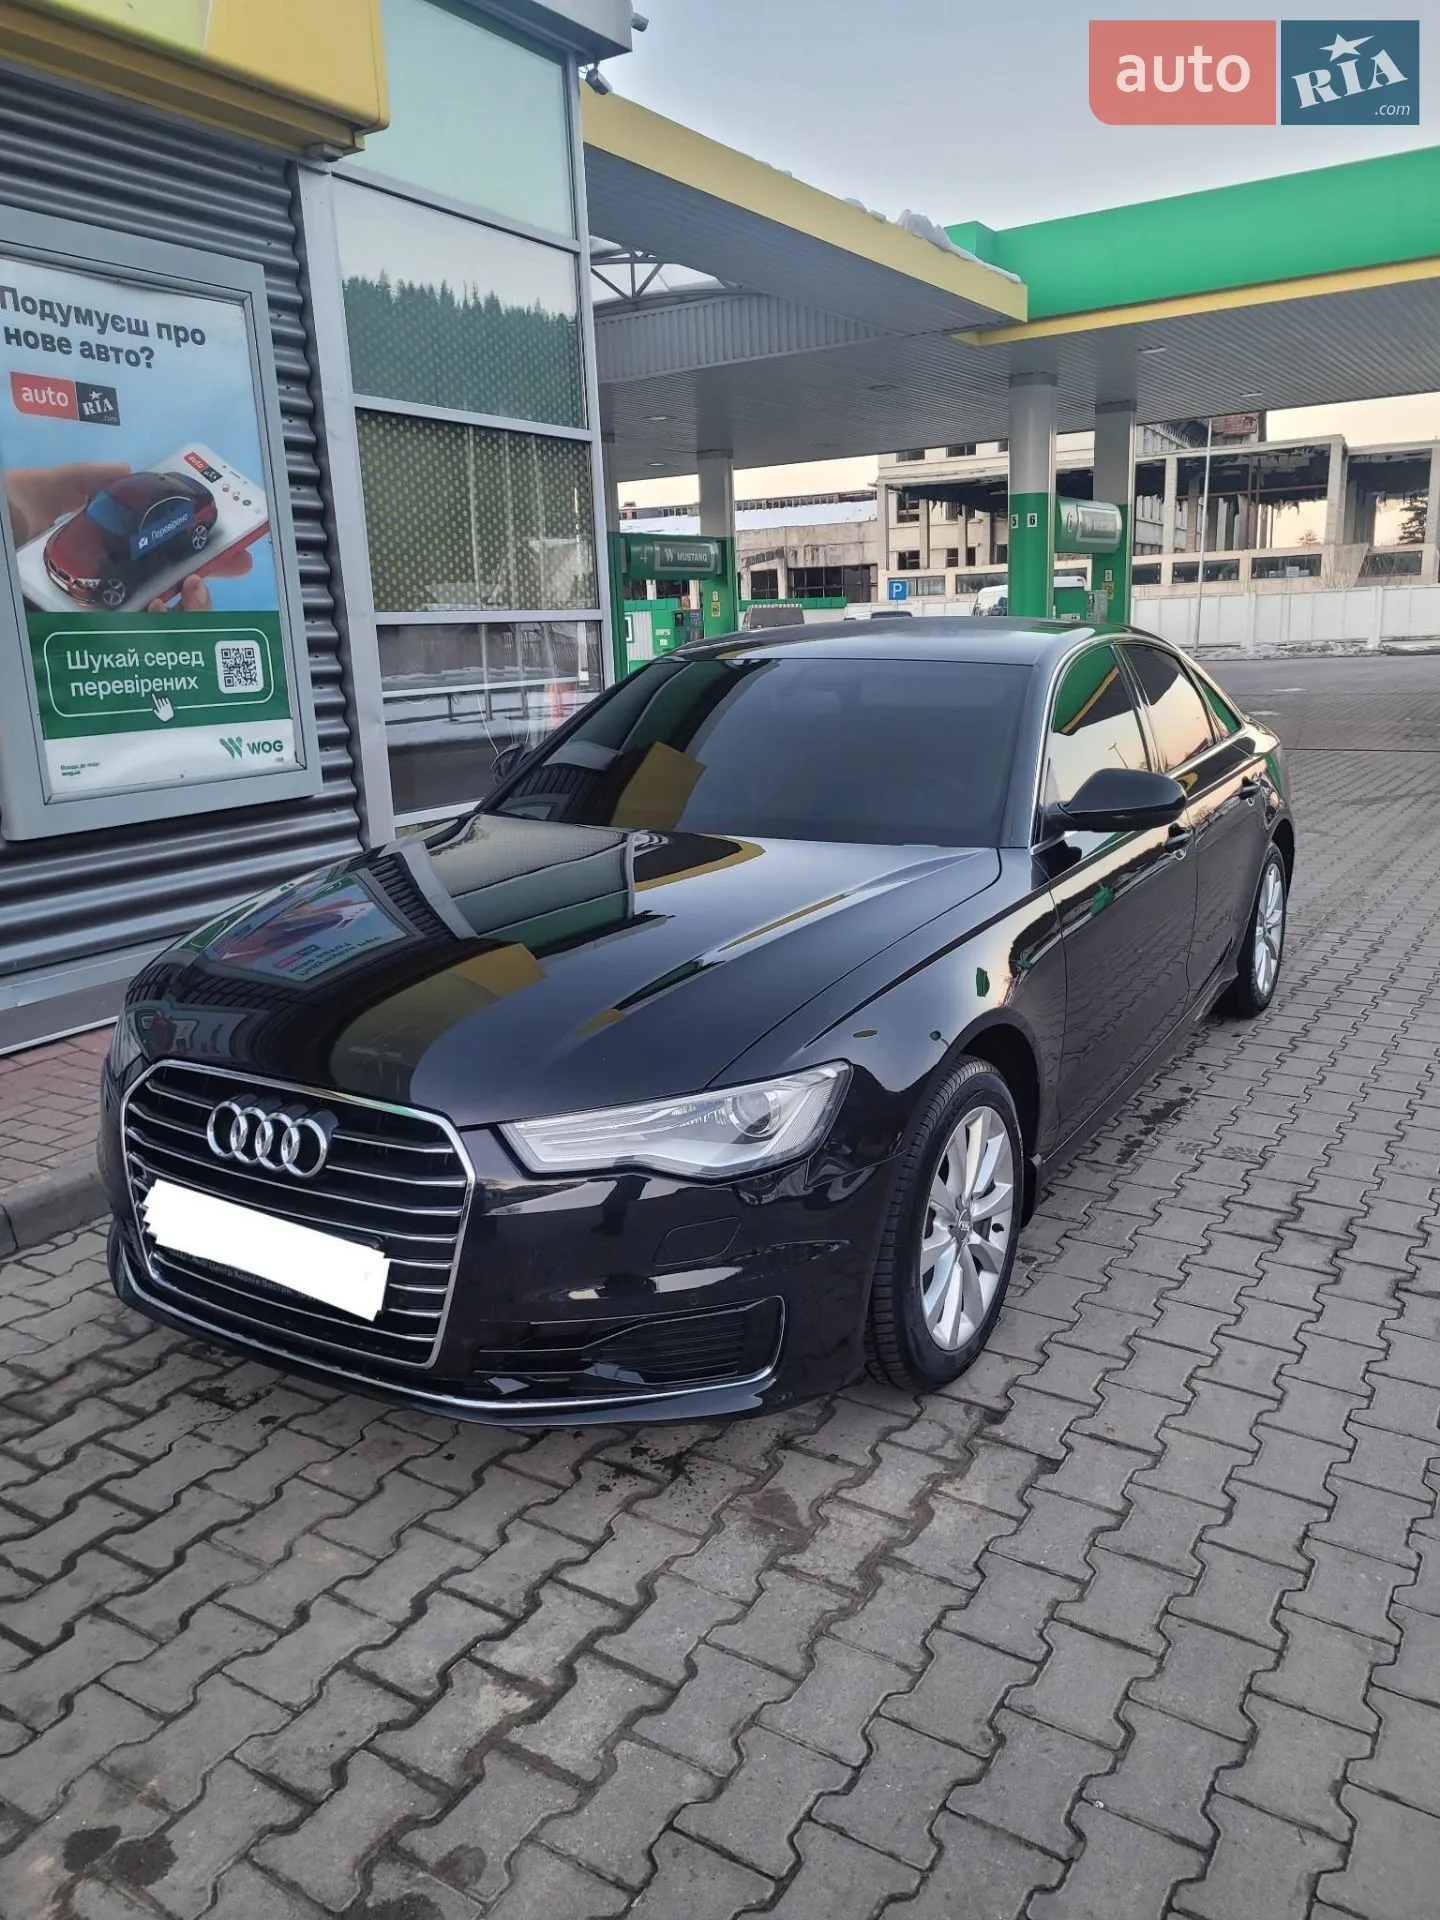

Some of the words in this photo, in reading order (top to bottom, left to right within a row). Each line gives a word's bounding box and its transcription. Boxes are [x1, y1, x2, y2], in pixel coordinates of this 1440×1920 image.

[0, 285, 149, 336] Подумуєш
[156, 322, 206, 347] про
[4, 326, 72, 355] нове
[80, 340, 155, 368] авто?
[21, 386, 69, 407] auto
[82, 398, 114, 416] RIA
[1012, 516, 1017, 527] 5
[1029, 515, 1036, 526] 6
[677, 551, 708, 562] MUSTANG
[892, 583, 903, 599] P
[66, 648, 140, 674] Шукай
[144, 649, 205, 671] серед
[71, 674, 199, 700] перевірених
[246, 740, 284, 755] WOG
